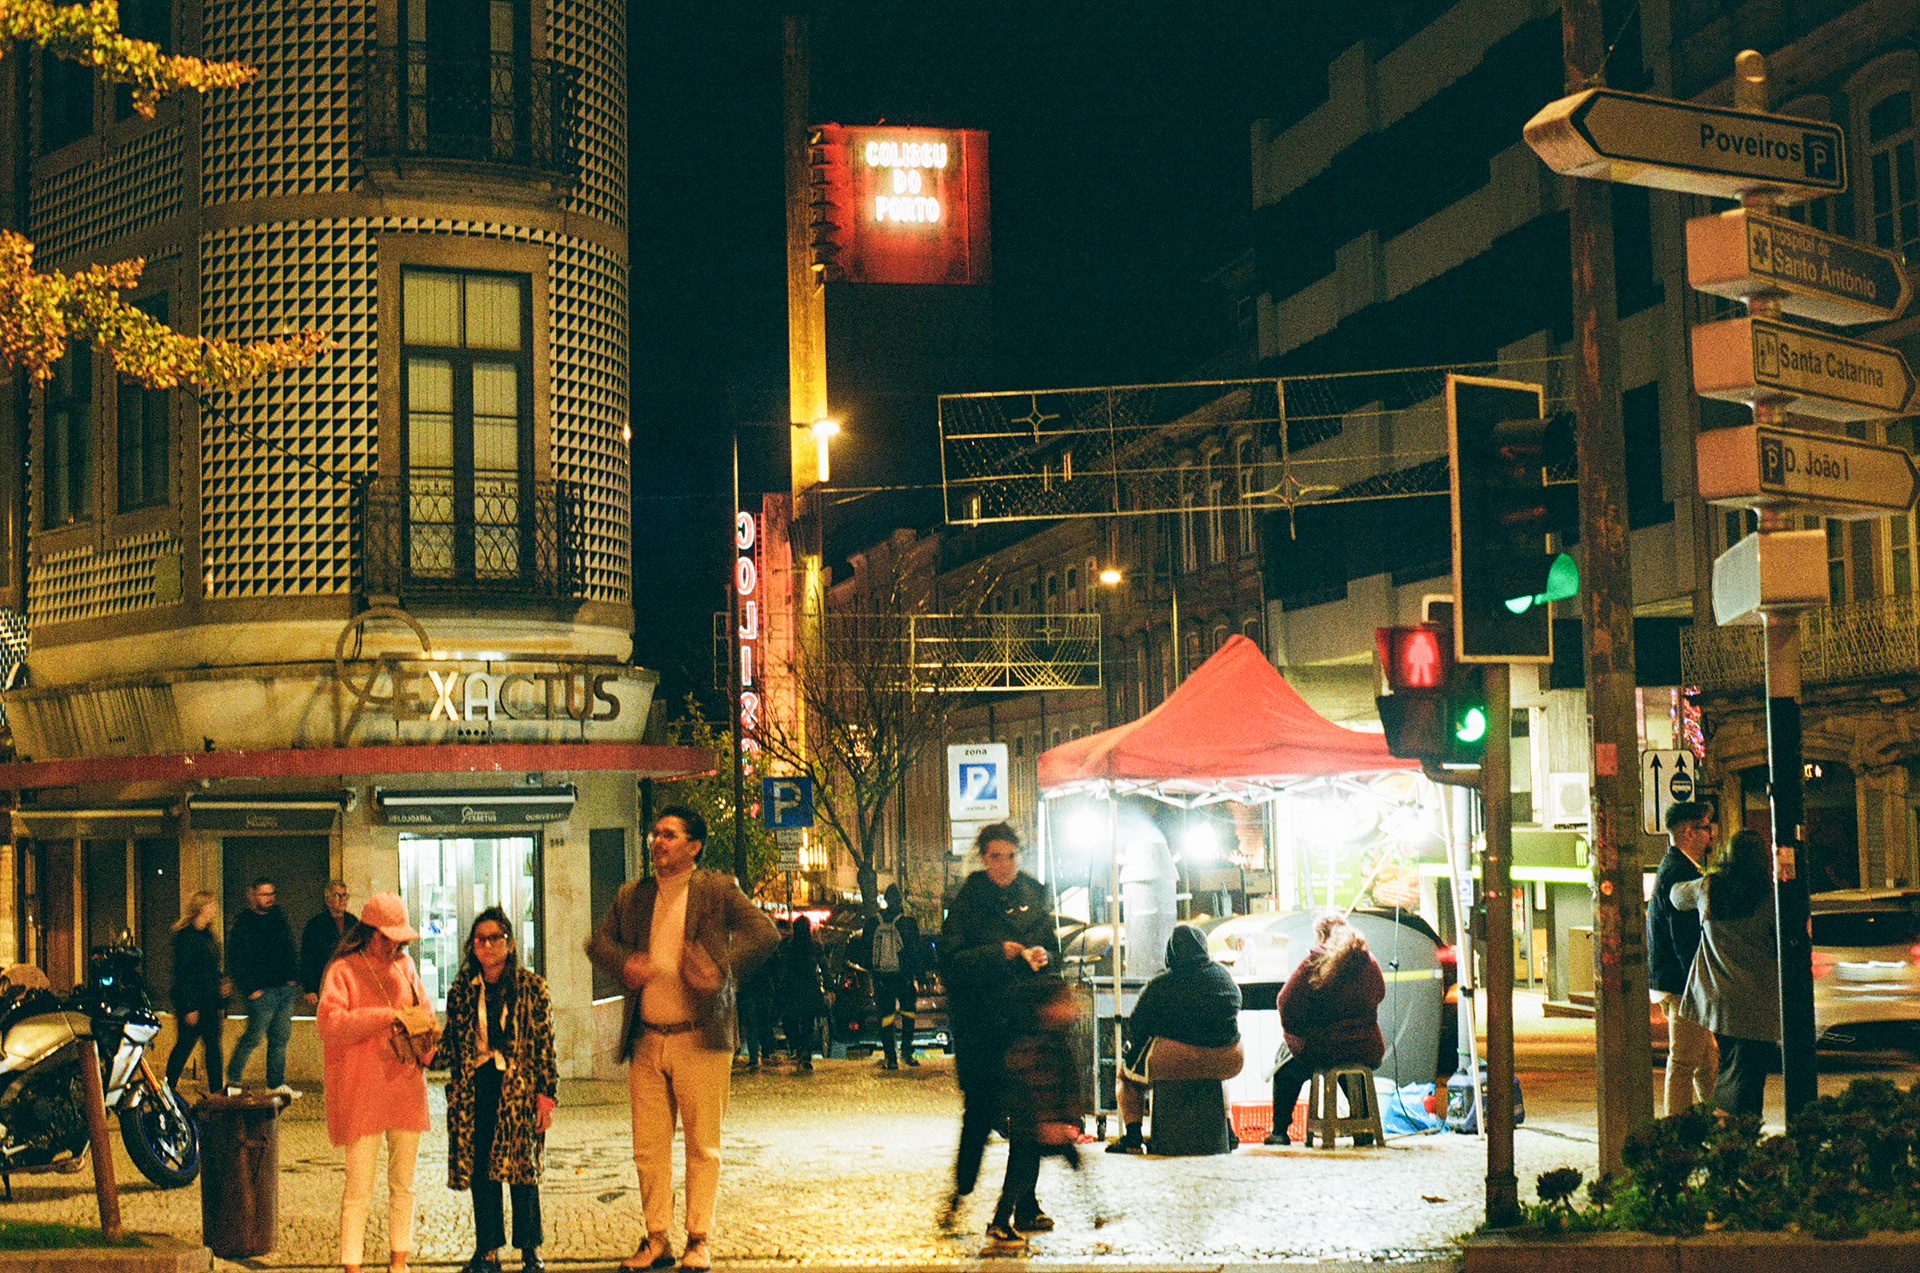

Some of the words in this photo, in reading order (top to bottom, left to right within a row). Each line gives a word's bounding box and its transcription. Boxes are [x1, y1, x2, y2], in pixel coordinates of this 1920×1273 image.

[865, 141, 948, 169] COLISEU
[1700, 123, 1801, 162] Poveiros
[892, 168, 922, 195] DO
[875, 195, 940, 223] PORTO
[1773, 247, 1817, 281] Santo
[1821, 260, 1876, 299] António
[1779, 343, 1822, 375] Santa
[1825, 352, 1884, 388] Catarina
[1784, 447, 1800, 473] D.
[1805, 451, 1840, 480] João
[392, 665, 621, 722] EXACTUS
[964, 748, 988, 756] zona
[966, 766, 990, 801] P
[773, 781, 801, 824] P
